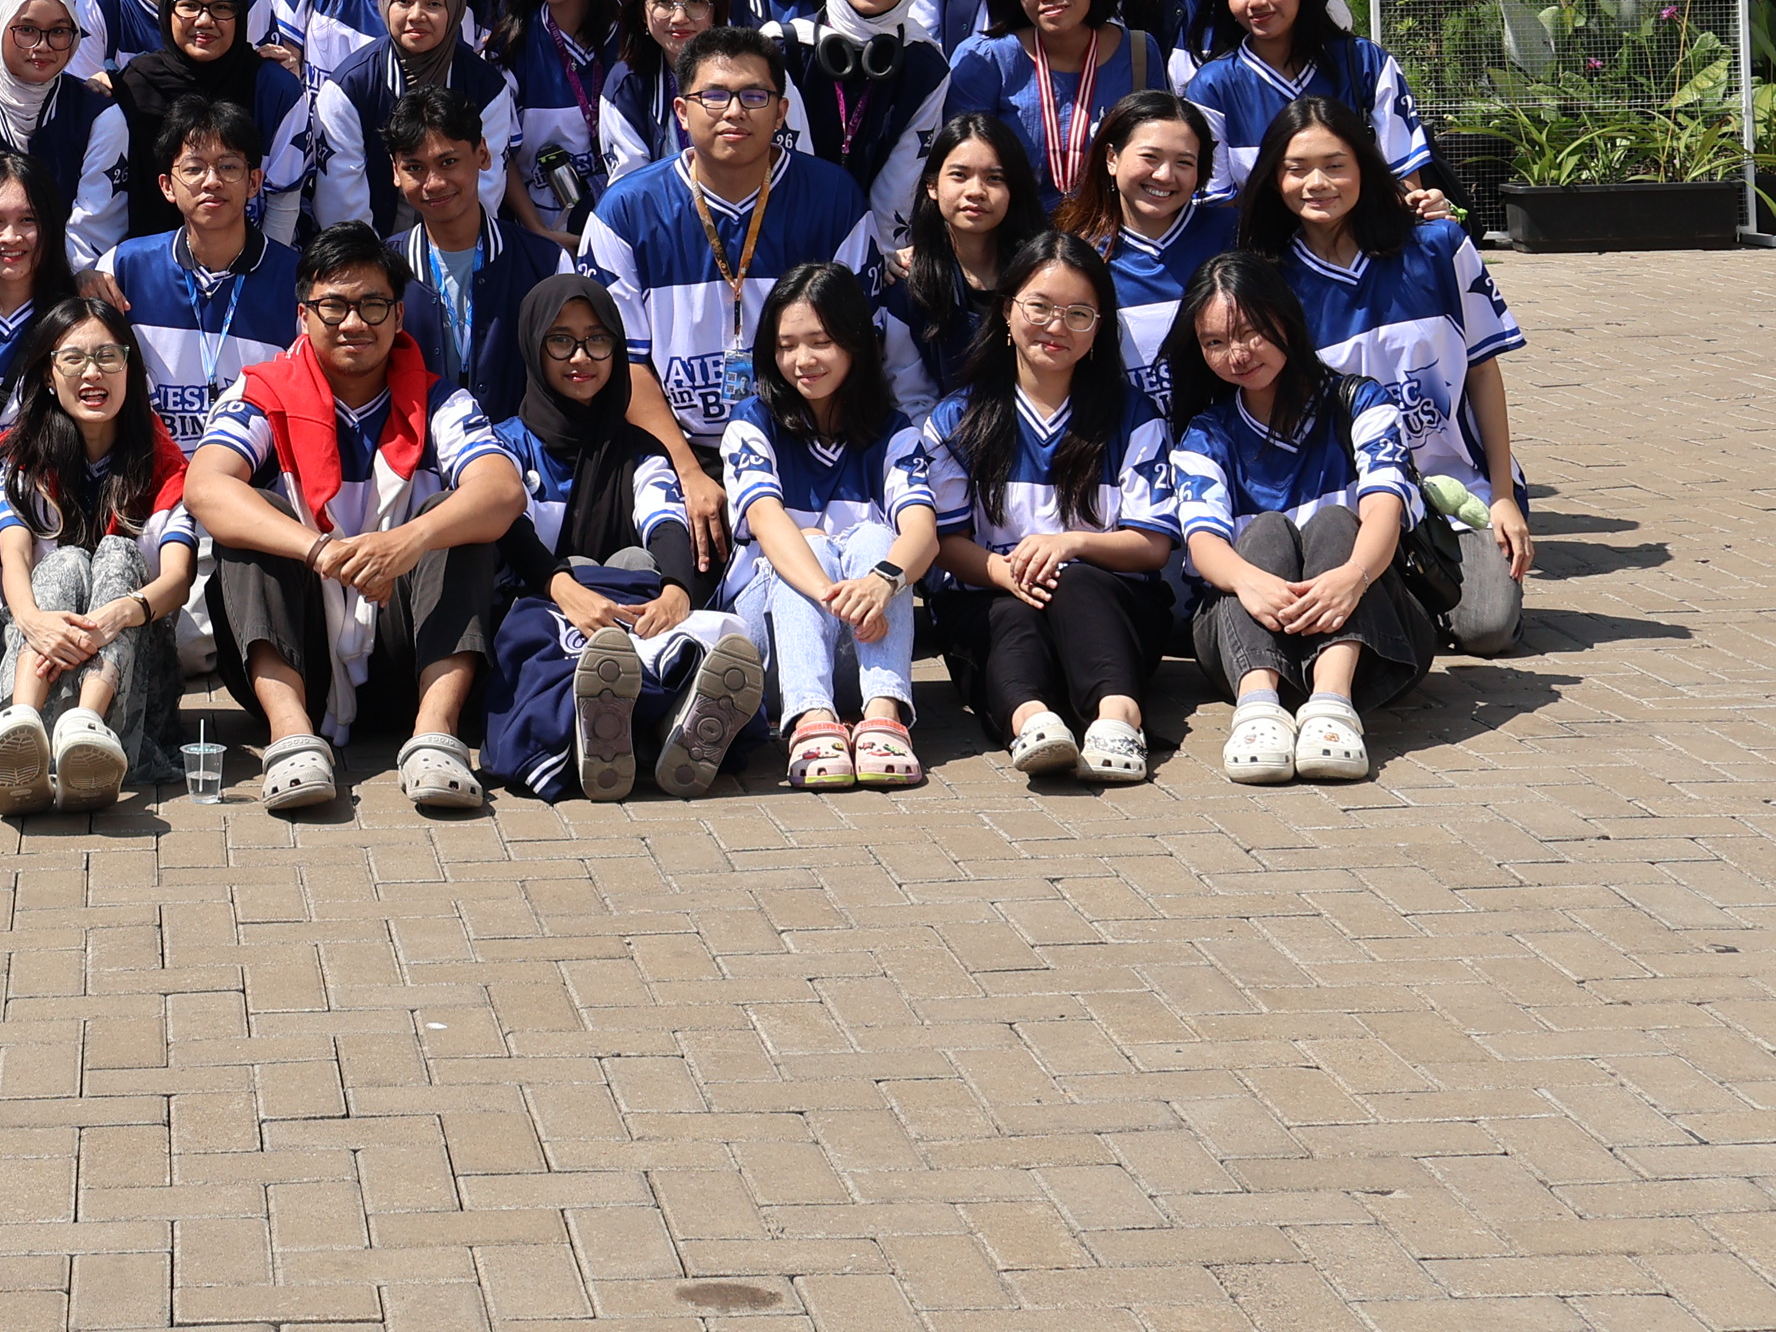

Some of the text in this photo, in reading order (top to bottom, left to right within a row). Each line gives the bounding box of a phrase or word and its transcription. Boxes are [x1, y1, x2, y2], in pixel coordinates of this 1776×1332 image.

[1401, 95, 1417, 118] 2
[776, 132, 793, 148] 26
[113, 168, 128, 184] 26
[1485, 277, 1501, 301] 2
[667, 356, 726, 388] AIE
[158, 388, 210, 412] IES
[670, 390, 695, 405] in
[160, 414, 216, 439] BIN
[912, 457, 926, 477] 2
[1178, 482, 1192, 502] 6
